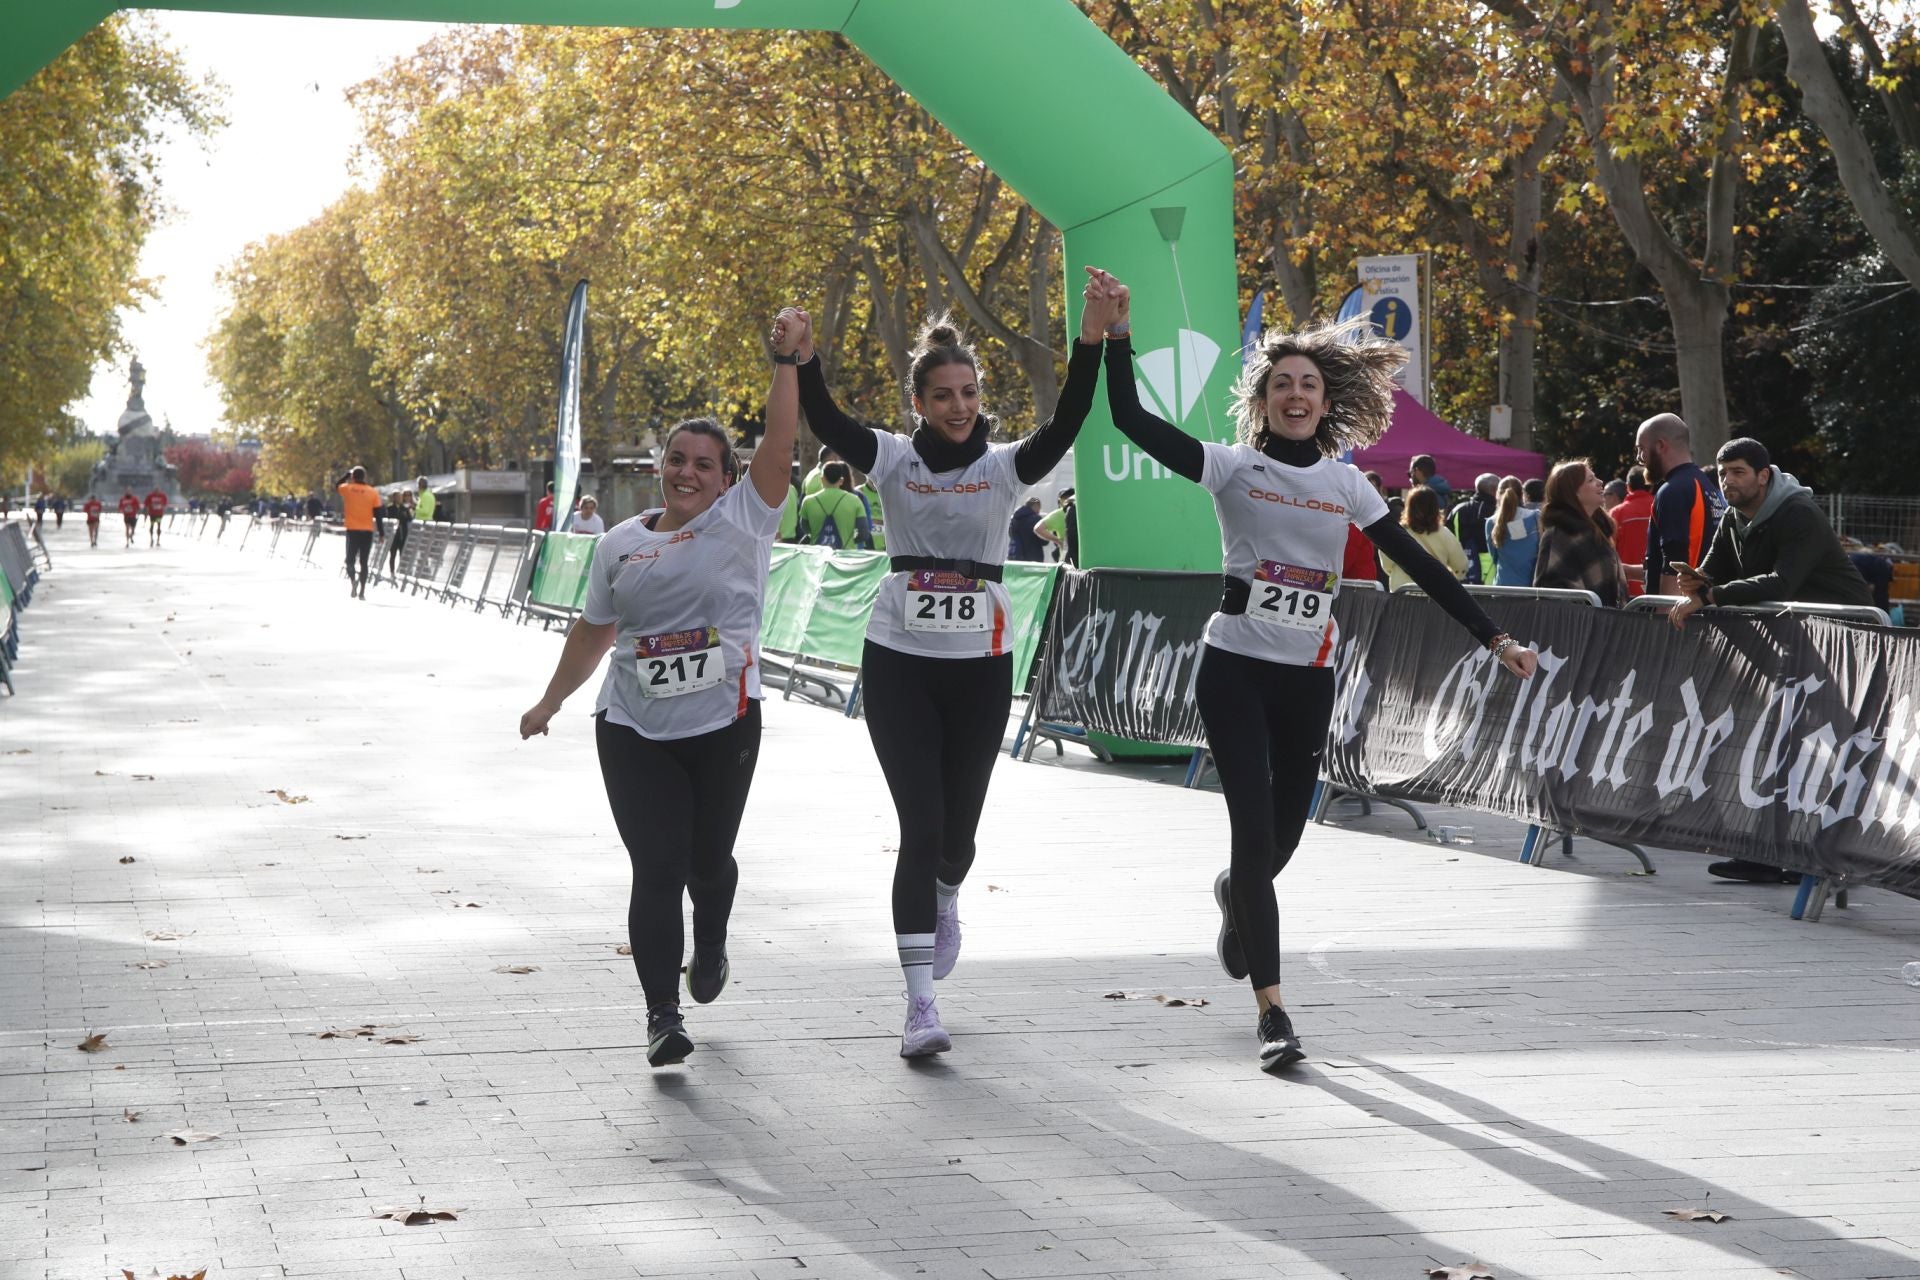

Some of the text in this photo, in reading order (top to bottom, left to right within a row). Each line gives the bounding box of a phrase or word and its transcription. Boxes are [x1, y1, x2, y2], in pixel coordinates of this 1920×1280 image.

[1365, 264, 1401, 273] Oficina de
[1248, 489, 1345, 515] COLLOSA
[916, 594, 975, 620] 218
[1260, 586, 1320, 619] 219
[648, 652, 708, 686] 217
[1497, 640, 1654, 793] Norte
[1653, 676, 1735, 803] de
